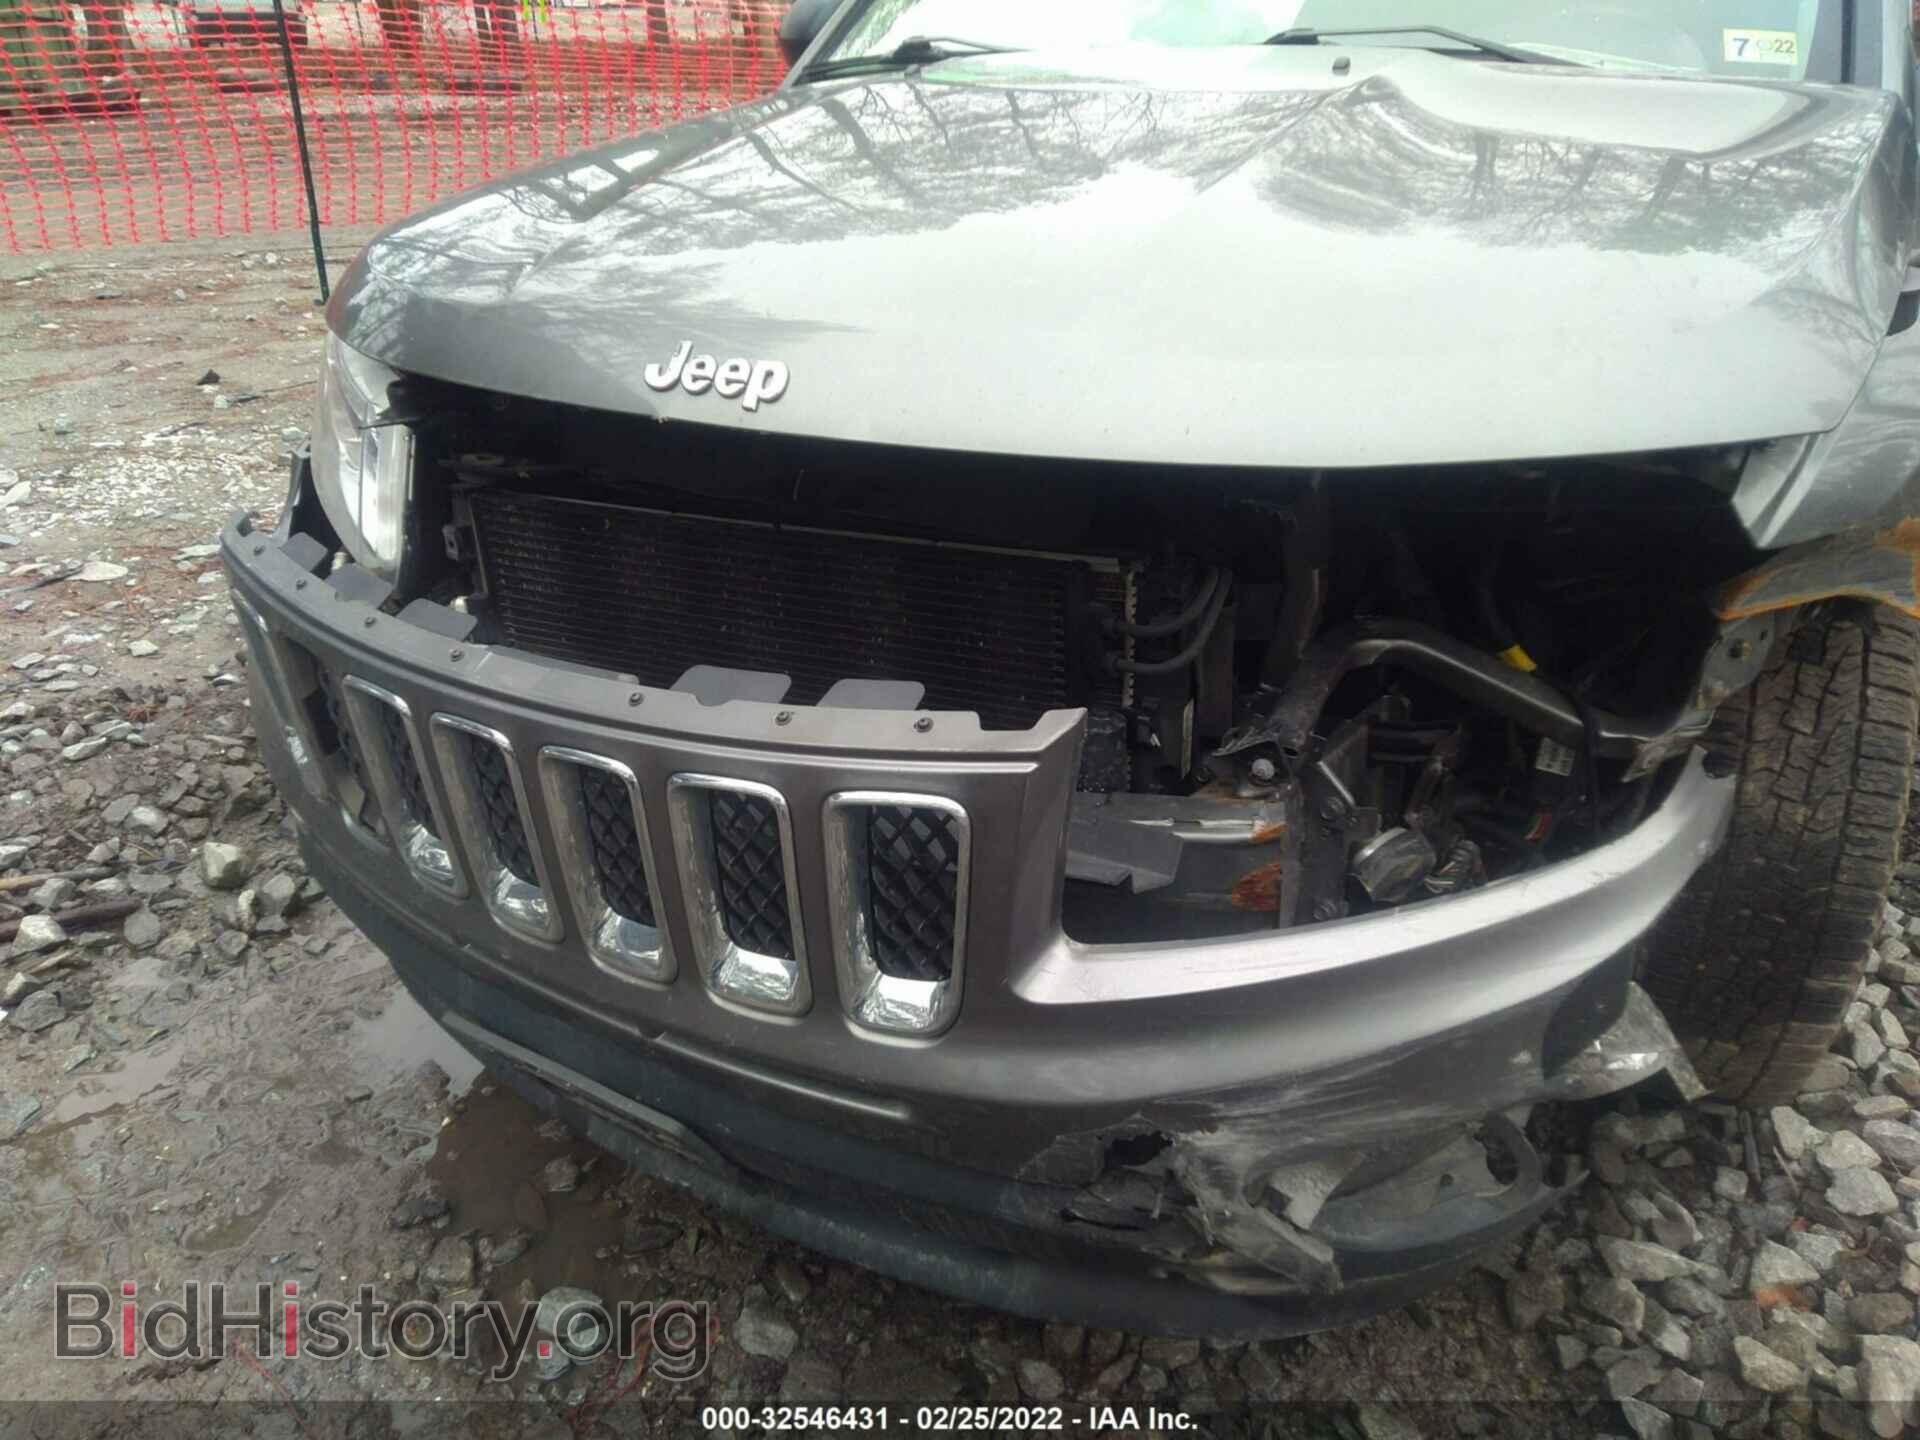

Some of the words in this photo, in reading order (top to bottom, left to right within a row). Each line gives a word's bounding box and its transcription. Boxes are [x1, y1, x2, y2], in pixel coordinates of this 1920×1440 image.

[1732, 37, 1751, 57] 7
[1774, 38, 1796, 54] 22
[644, 340, 790, 413] Jeep
